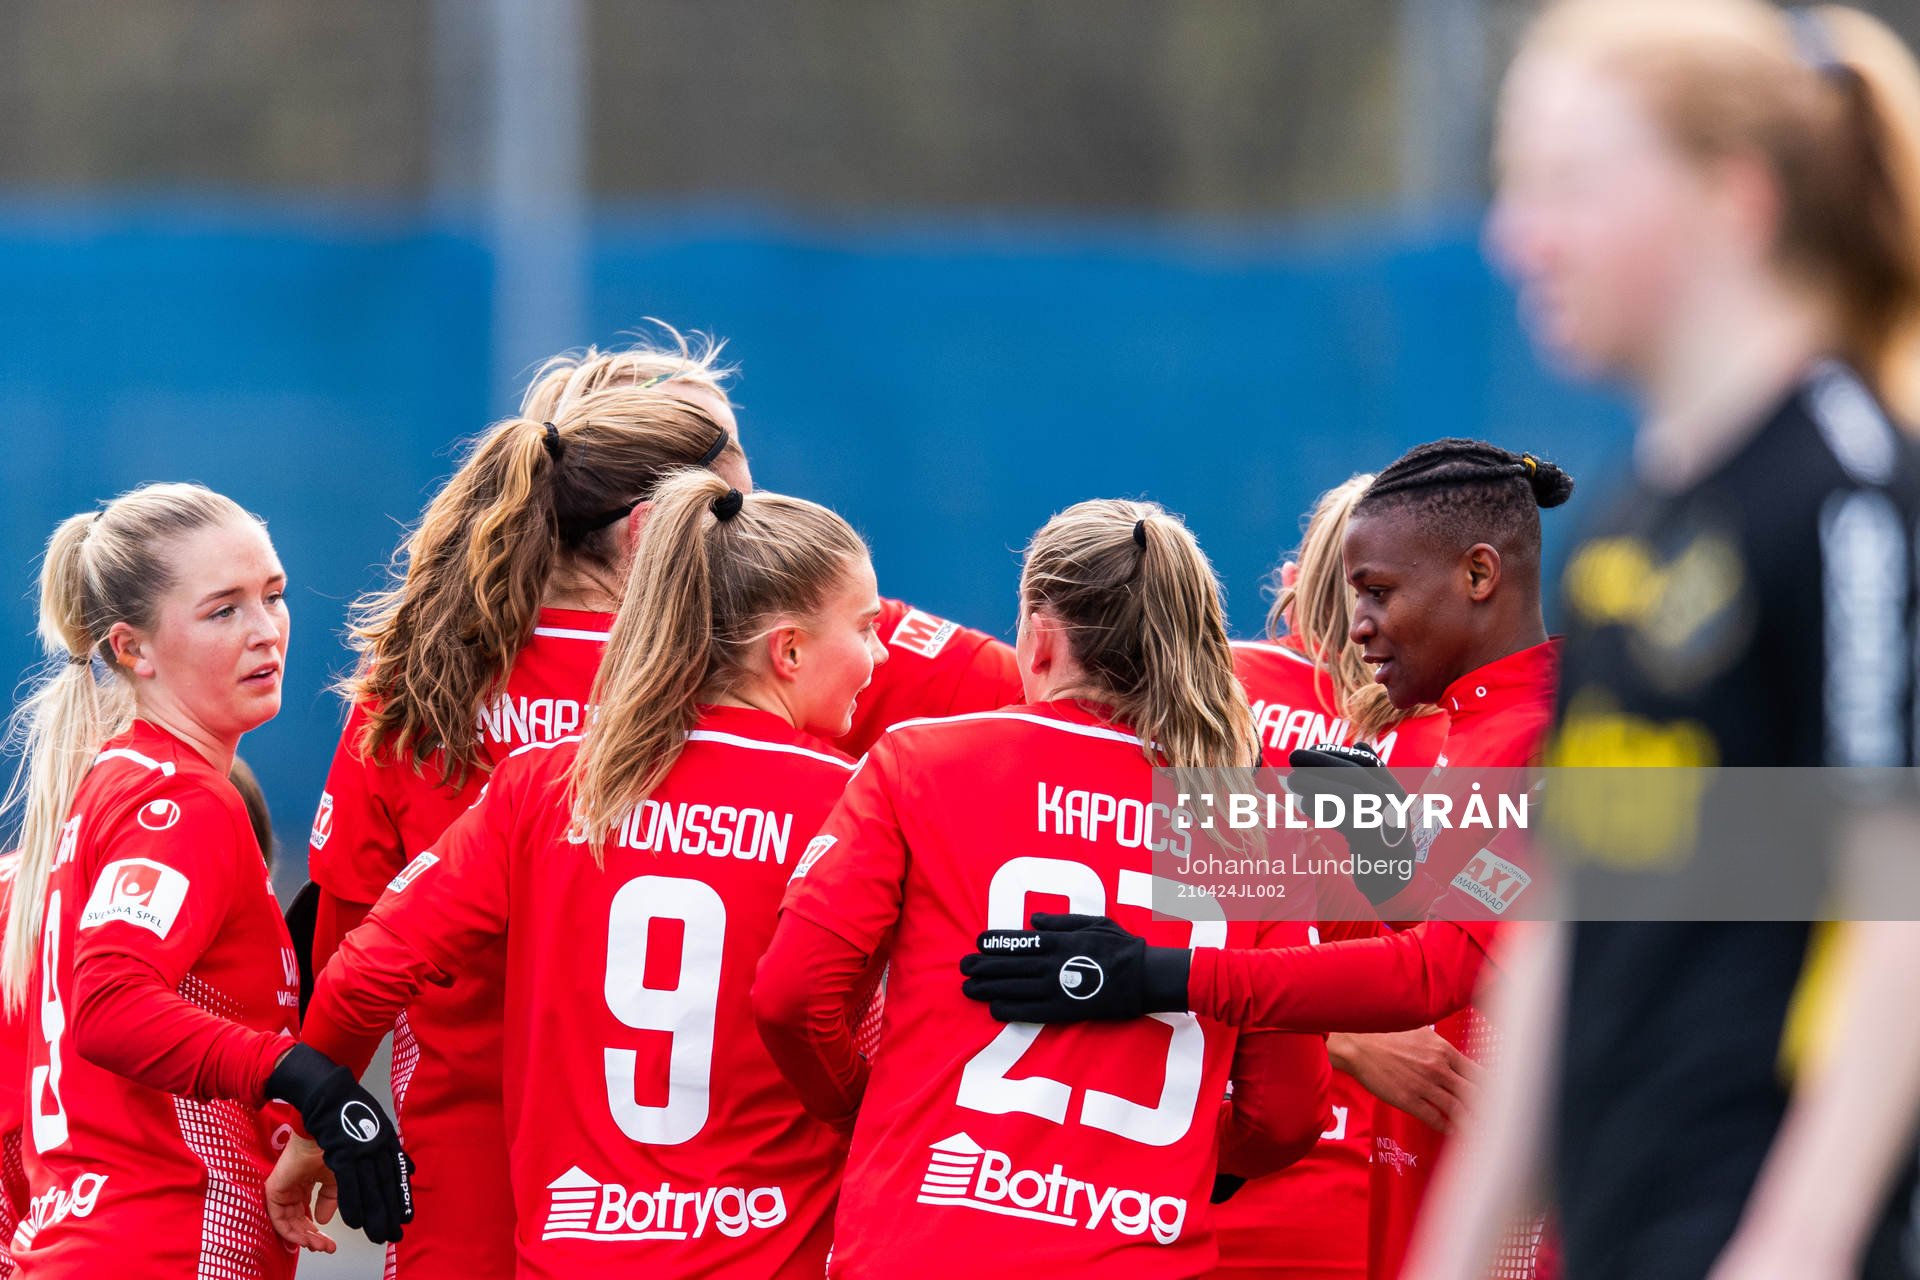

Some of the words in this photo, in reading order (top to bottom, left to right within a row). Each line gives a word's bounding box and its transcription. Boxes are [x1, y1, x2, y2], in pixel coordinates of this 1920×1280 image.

[1316, 742, 1384, 768] uhlsport
[567, 796, 793, 865] SMONSSON
[1038, 781, 1194, 859] KAPOCS
[136, 910, 162, 929] SPEL
[982, 933, 1041, 951] uhlsport
[604, 875, 727, 1145] 9
[956, 856, 1228, 1147] 23
[397, 1152, 412, 1216] uhlsport
[596, 1182, 788, 1239] Botrygg
[974, 1149, 1188, 1245] Botrygg
